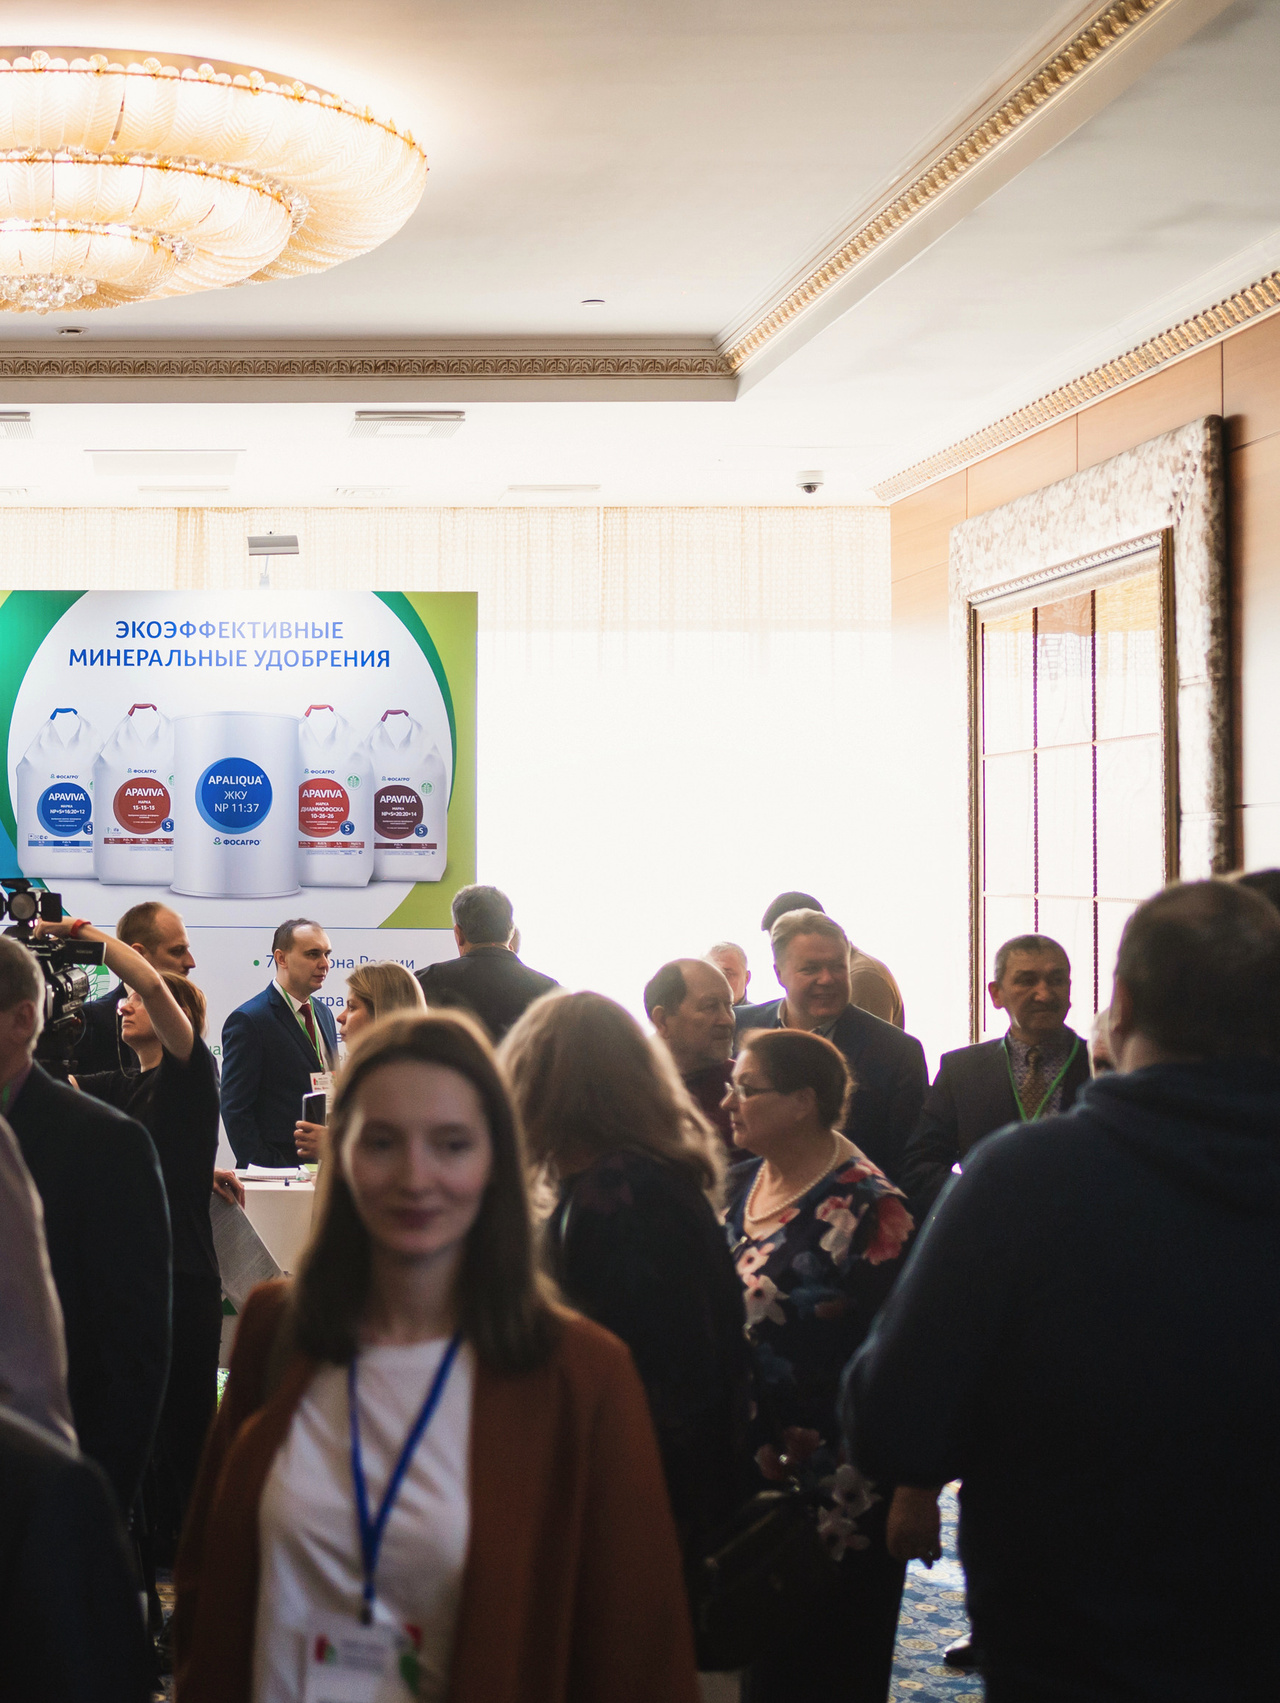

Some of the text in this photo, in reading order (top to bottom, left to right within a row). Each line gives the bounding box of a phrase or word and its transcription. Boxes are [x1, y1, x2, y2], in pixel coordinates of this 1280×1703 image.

[115, 620, 344, 639] ЭКОЭФФЕКТИВНЫЕ
[69, 649, 390, 671] МИНЕРАЛЬНЫЕ УДОБРЕНИЯ
[208, 775, 262, 787] APALIQUA
[48, 792, 85, 801] APAVIVA
[125, 788, 164, 797] APAVIVA
[224, 791, 248, 800] ЖКУ
[302, 789, 343, 798] APAVIVA
[380, 795, 417, 804] APAVIVA
[214, 803, 259, 812] NP 11:37
